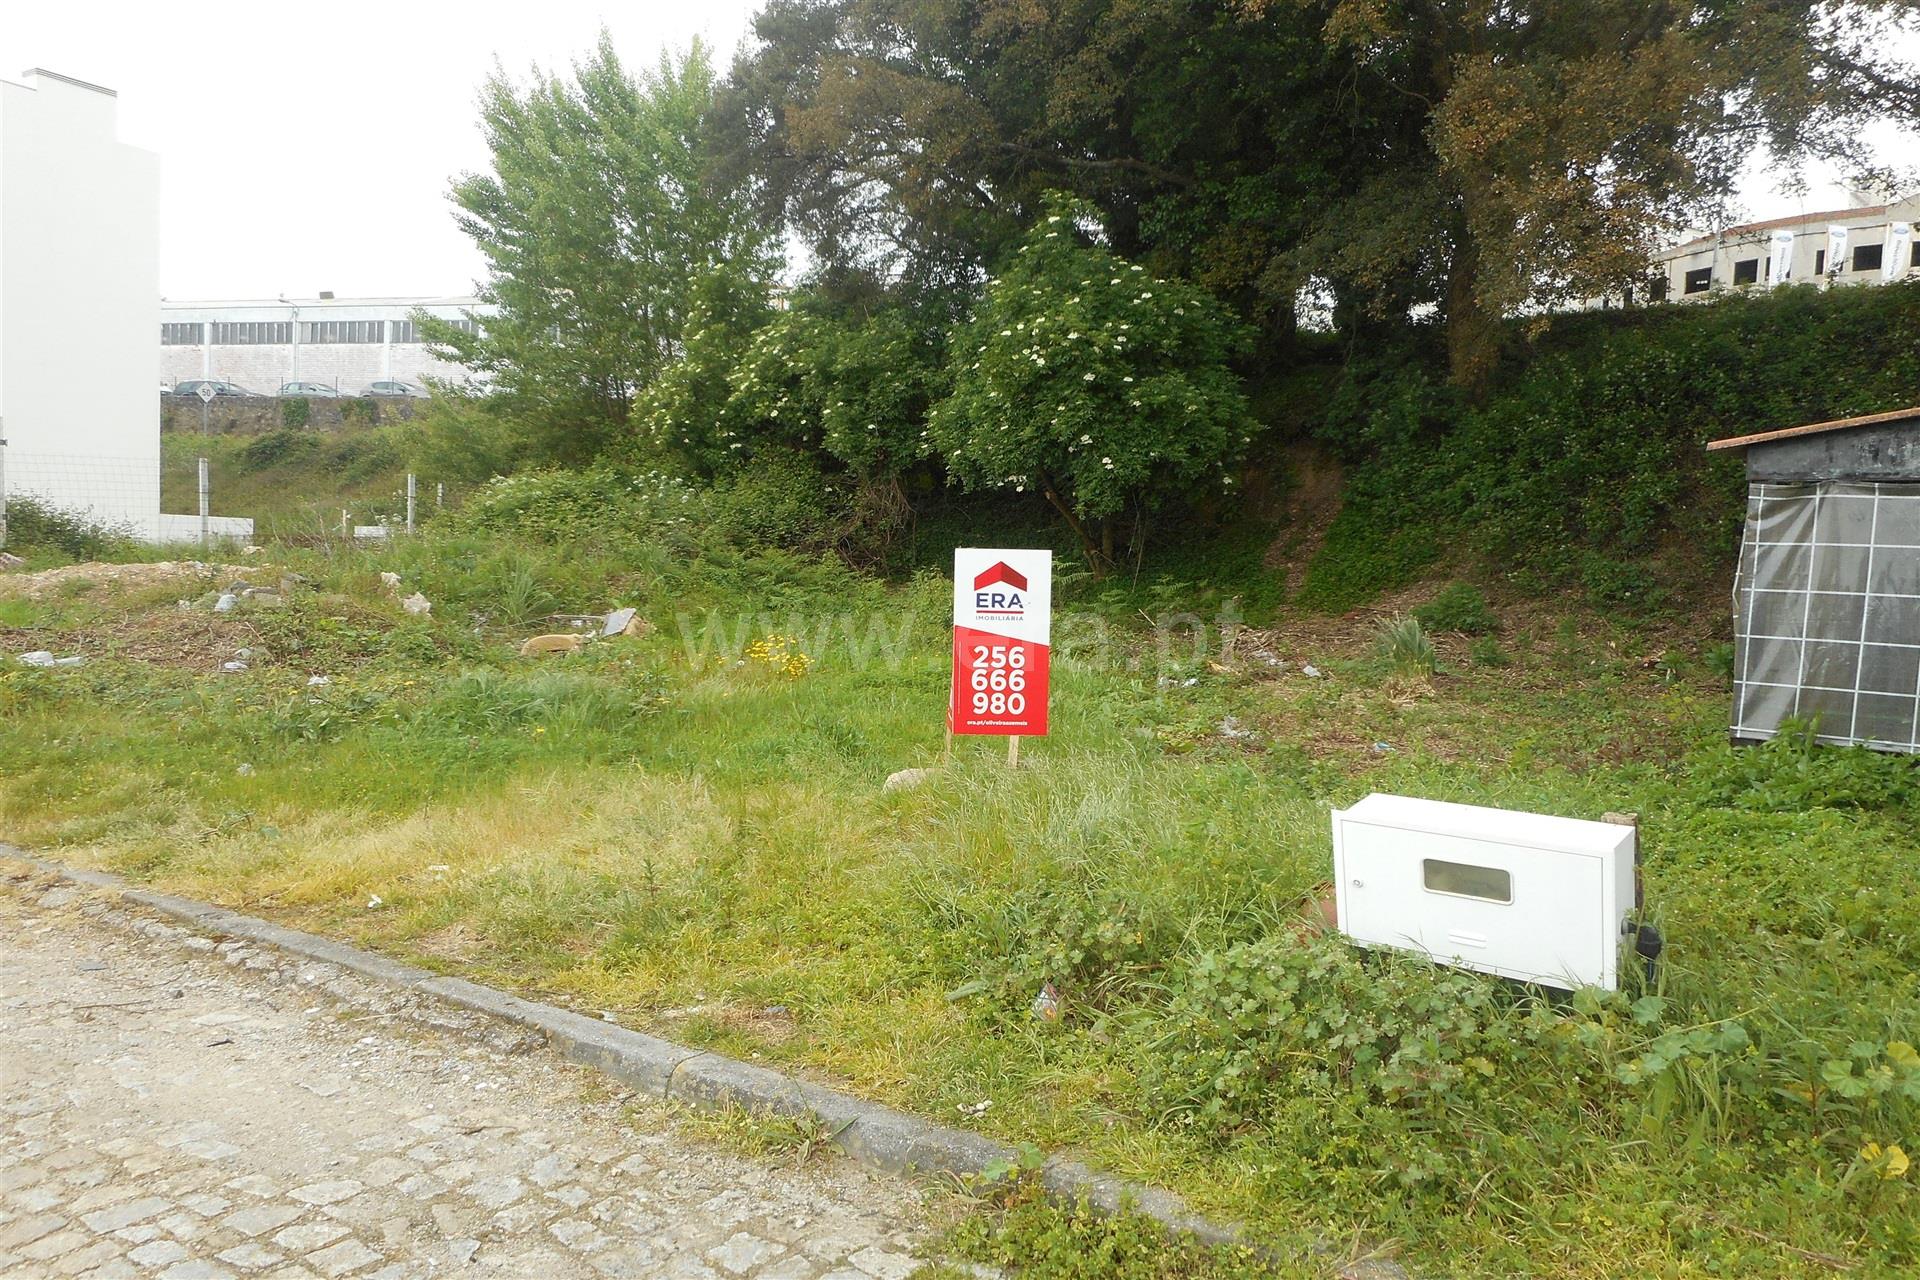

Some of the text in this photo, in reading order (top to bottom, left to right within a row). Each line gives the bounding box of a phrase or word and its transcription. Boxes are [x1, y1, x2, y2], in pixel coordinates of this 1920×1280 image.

[201, 388, 210, 396] 50
[975, 593, 1024, 609] ERA
[972, 645, 1025, 668] 256
[971, 669, 1025, 691] 666
[972, 692, 1026, 715] 980
